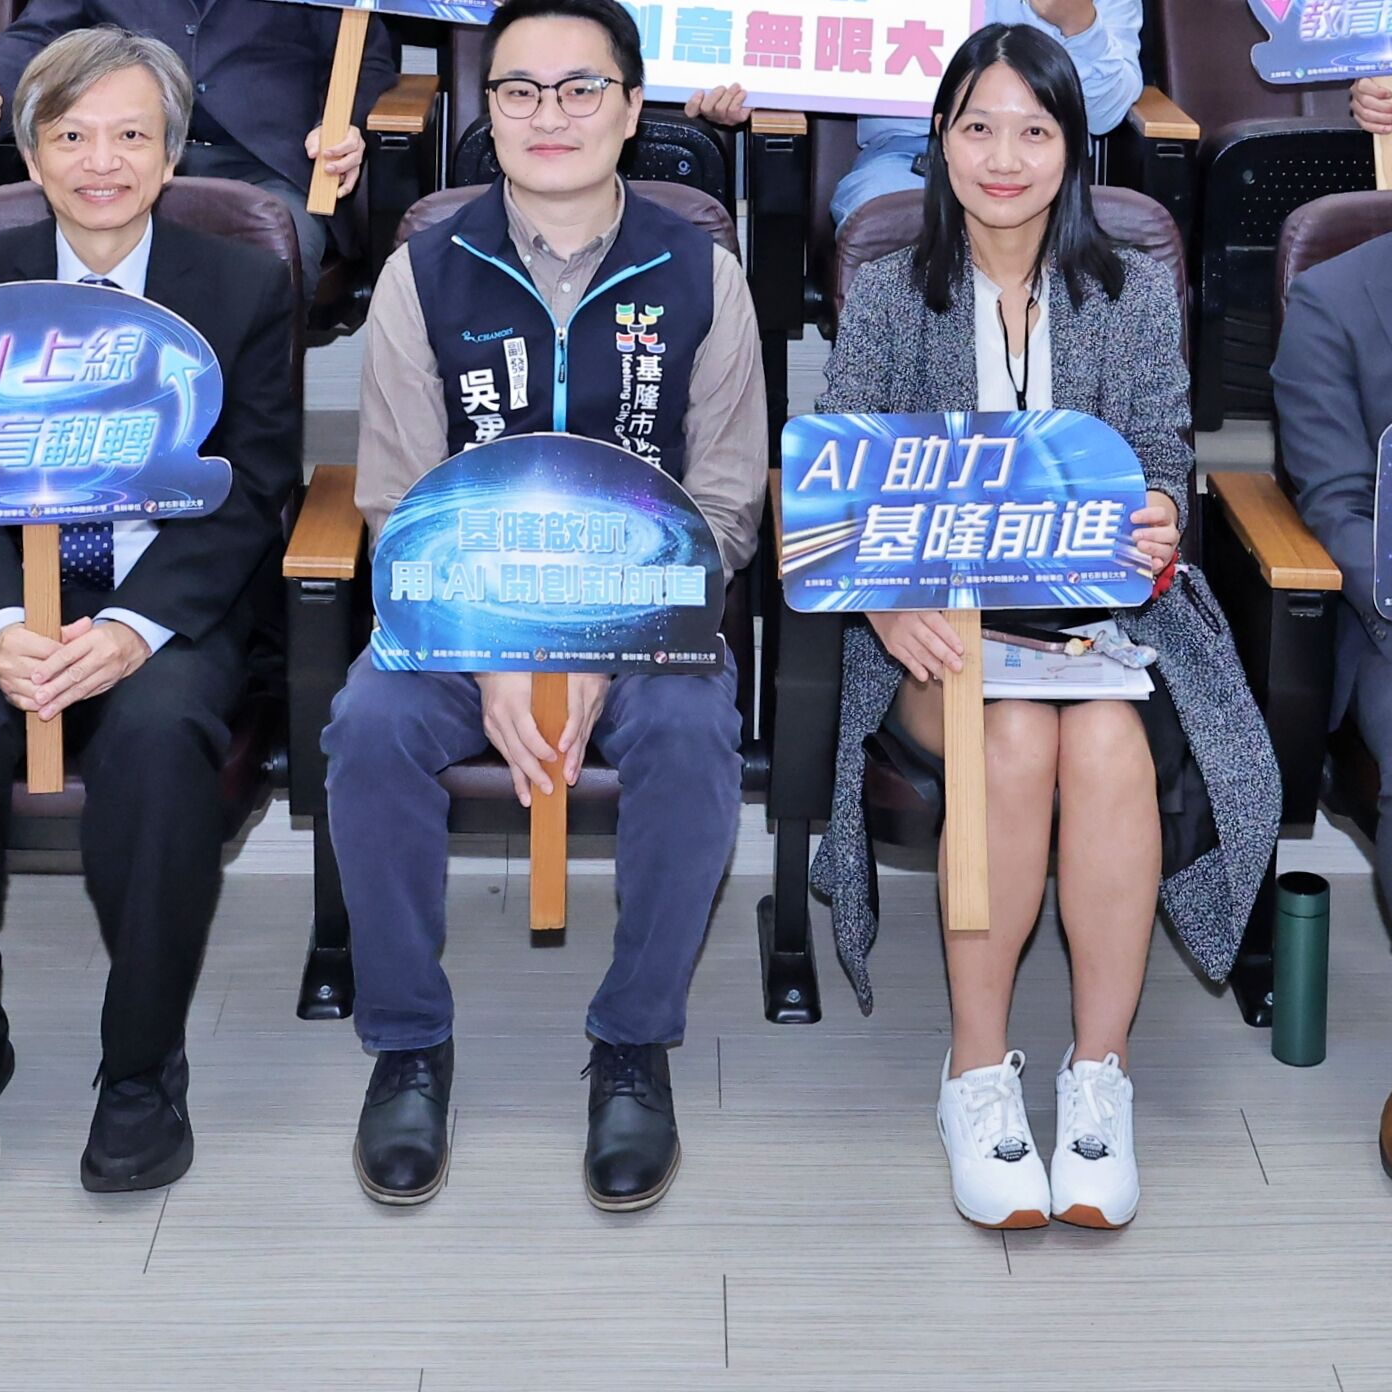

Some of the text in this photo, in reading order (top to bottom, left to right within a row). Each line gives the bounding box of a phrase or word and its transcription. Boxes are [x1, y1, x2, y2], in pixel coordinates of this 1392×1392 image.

[23, 327, 146, 384] 上線
[477, 328, 514, 342] CHAMOIS
[507, 339, 526, 407] 副發言人
[620, 353, 634, 400] Keelung
[628, 354, 664, 468] 基隆市
[797, 434, 1018, 493] AI 助力
[113, 503, 141, 513] 辦單位
[158, 499, 204, 508] 崇右影藝大學
[457, 510, 628, 555] 基隆啟航
[854, 499, 1125, 564] 基隆前進
[389, 560, 707, 607] 用 AI 開創新航道
[1035, 574, 1064, 583] 辦單位
[1080, 571, 1127, 580] 崇右影藝大學
[621, 652, 651, 661] 辦單位
